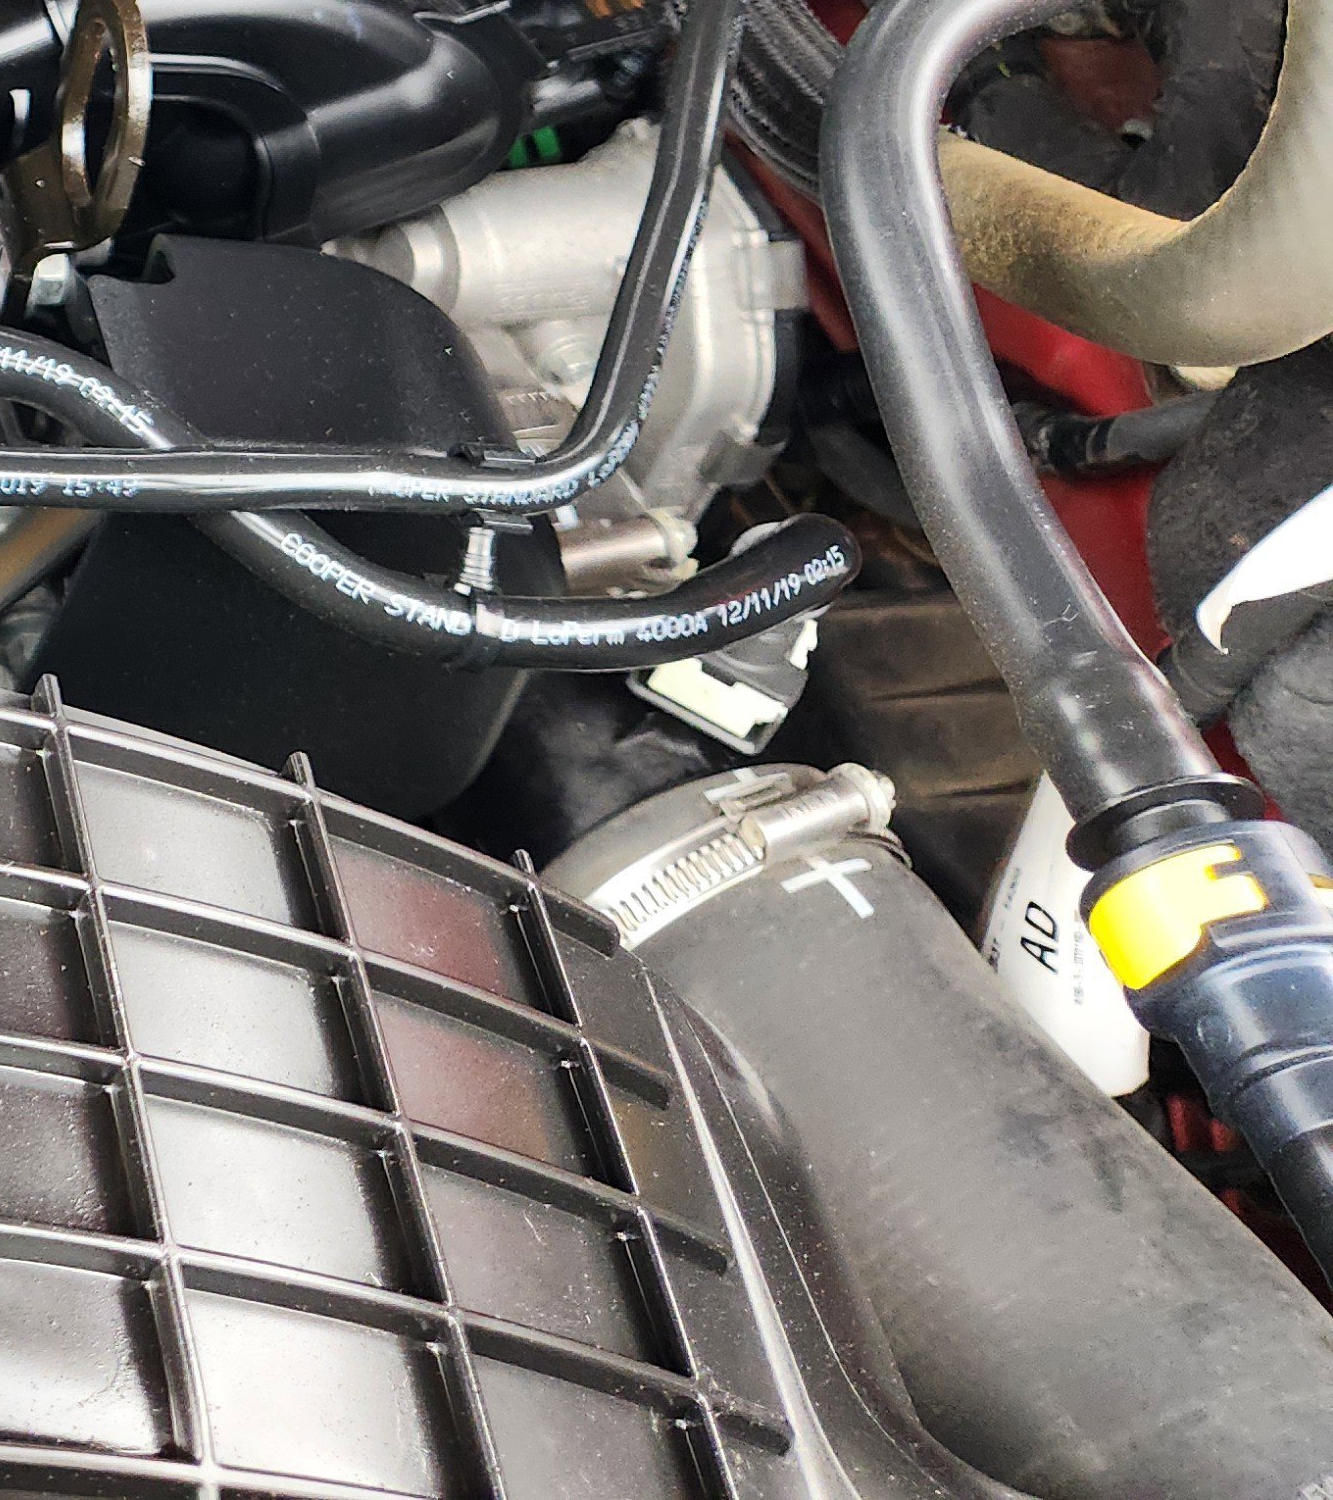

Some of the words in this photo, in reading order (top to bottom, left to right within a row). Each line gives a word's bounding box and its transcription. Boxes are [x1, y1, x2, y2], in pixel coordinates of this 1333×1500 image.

[281, 532, 377, 605] COOPER
[532, 619, 626, 646] LoPerm
[636, 610, 709, 643] 4000A
[716, 580, 801, 628] 12/11/19
[803, 545, 847, 588] 02:15
[1020, 901, 1059, 975] AD
